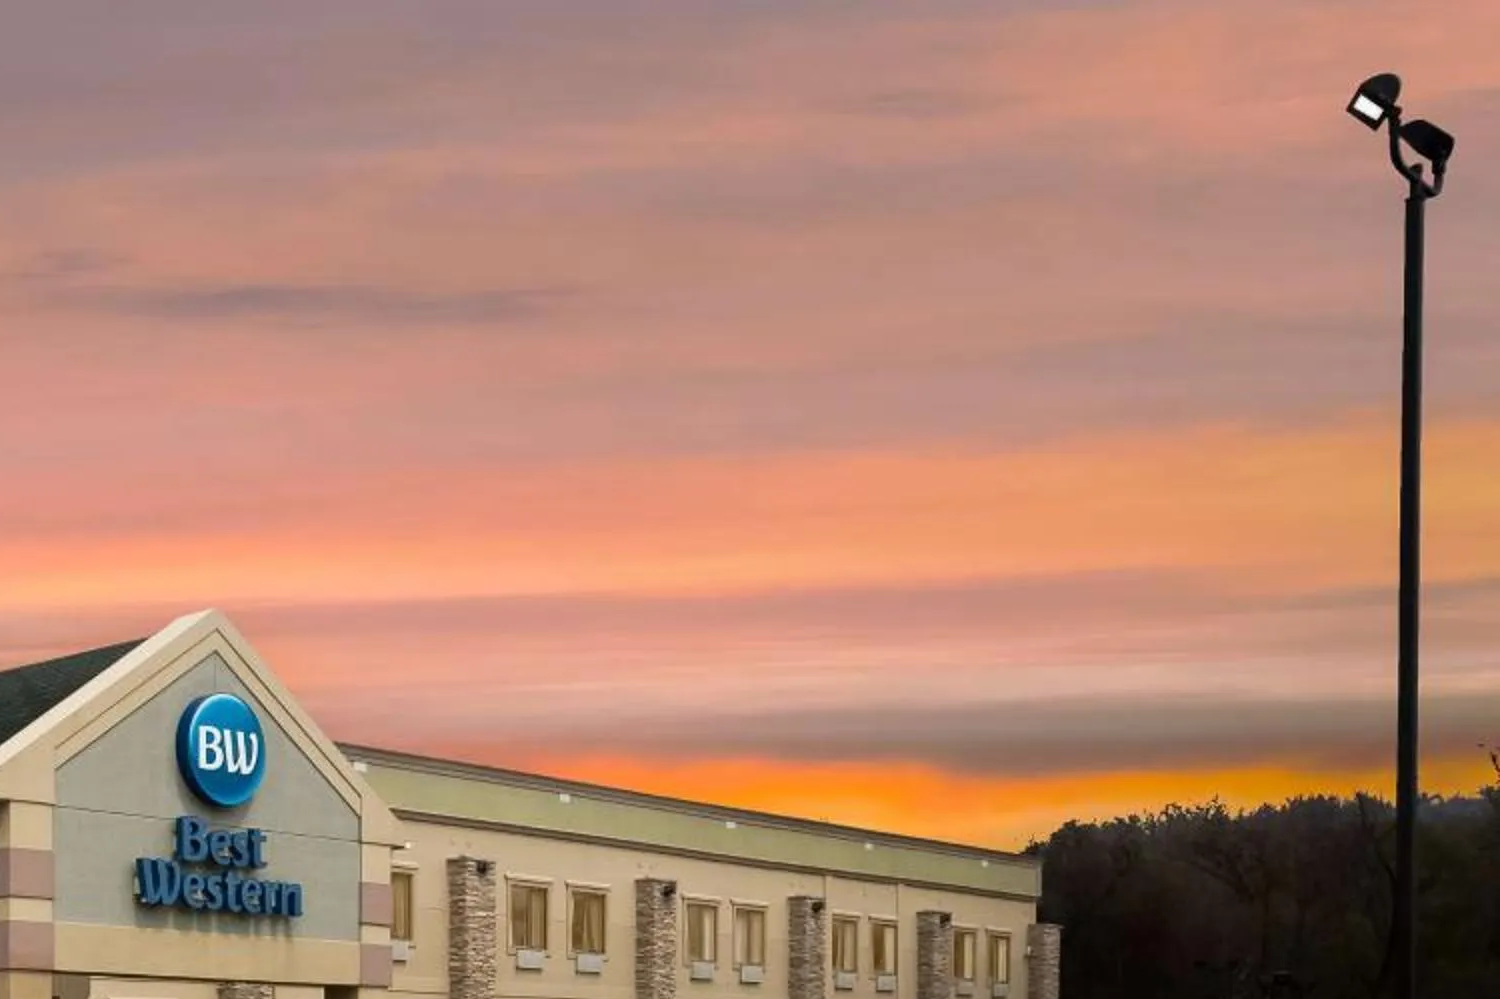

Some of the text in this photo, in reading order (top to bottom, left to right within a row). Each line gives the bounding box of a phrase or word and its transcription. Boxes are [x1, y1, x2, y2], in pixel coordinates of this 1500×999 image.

[199, 725, 258, 775] BW
[176, 816, 267, 868] Best
[135, 857, 303, 917] Western
